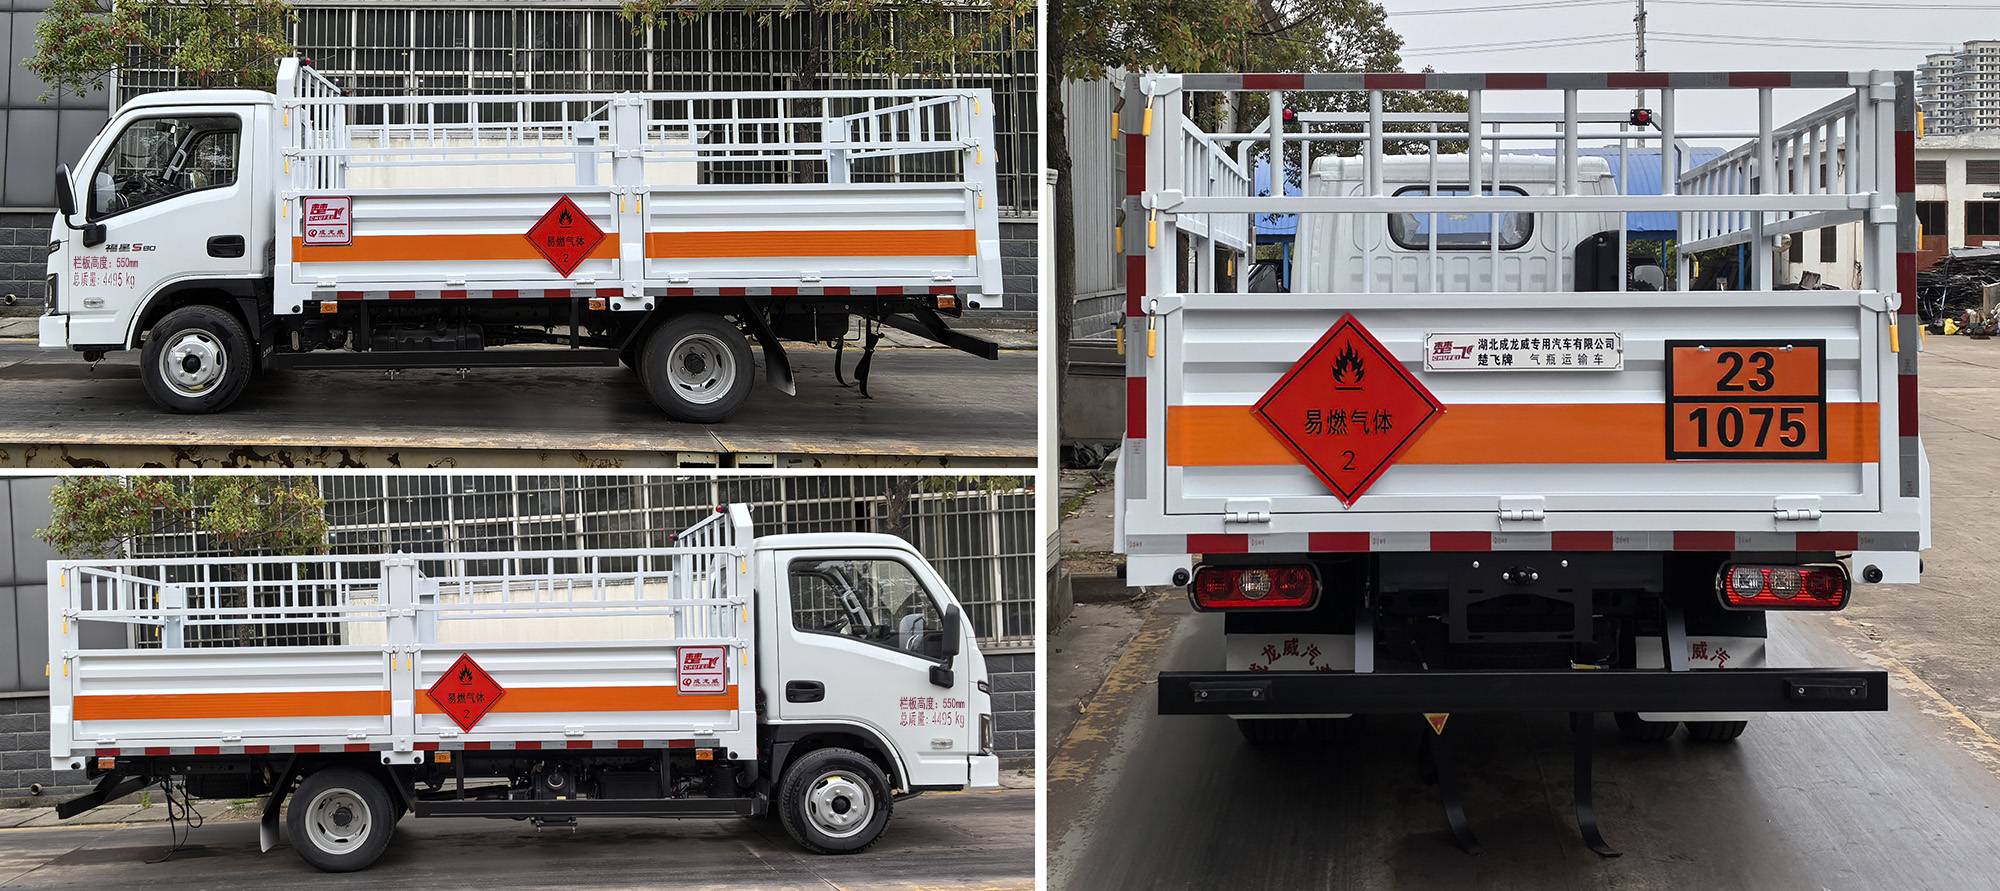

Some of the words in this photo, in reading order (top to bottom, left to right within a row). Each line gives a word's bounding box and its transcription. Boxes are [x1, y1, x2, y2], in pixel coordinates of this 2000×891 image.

[547, 236, 585, 247] 易燃气体
[116, 257, 139, 268] 550mm
[563, 254, 570, 263] 2
[125, 272, 136, 289] kg
[1477, 338, 1615, 351] 湖北成龙威专用汽车有限公司
[1477, 353, 1513, 366] 楚飞牌
[1529, 353, 1604, 366] 气瓶运输车
[1717, 351, 1775, 392] 23
[1304, 408, 1393, 435] 易燃气体
[1689, 407, 1806, 448] 1075
[1341, 450, 1356, 471] 2
[448, 692, 485, 704] 易燃气体
[942, 698, 965, 709] 550mm
[463, 709, 470, 718] 2
[955, 711, 965, 728] kg
